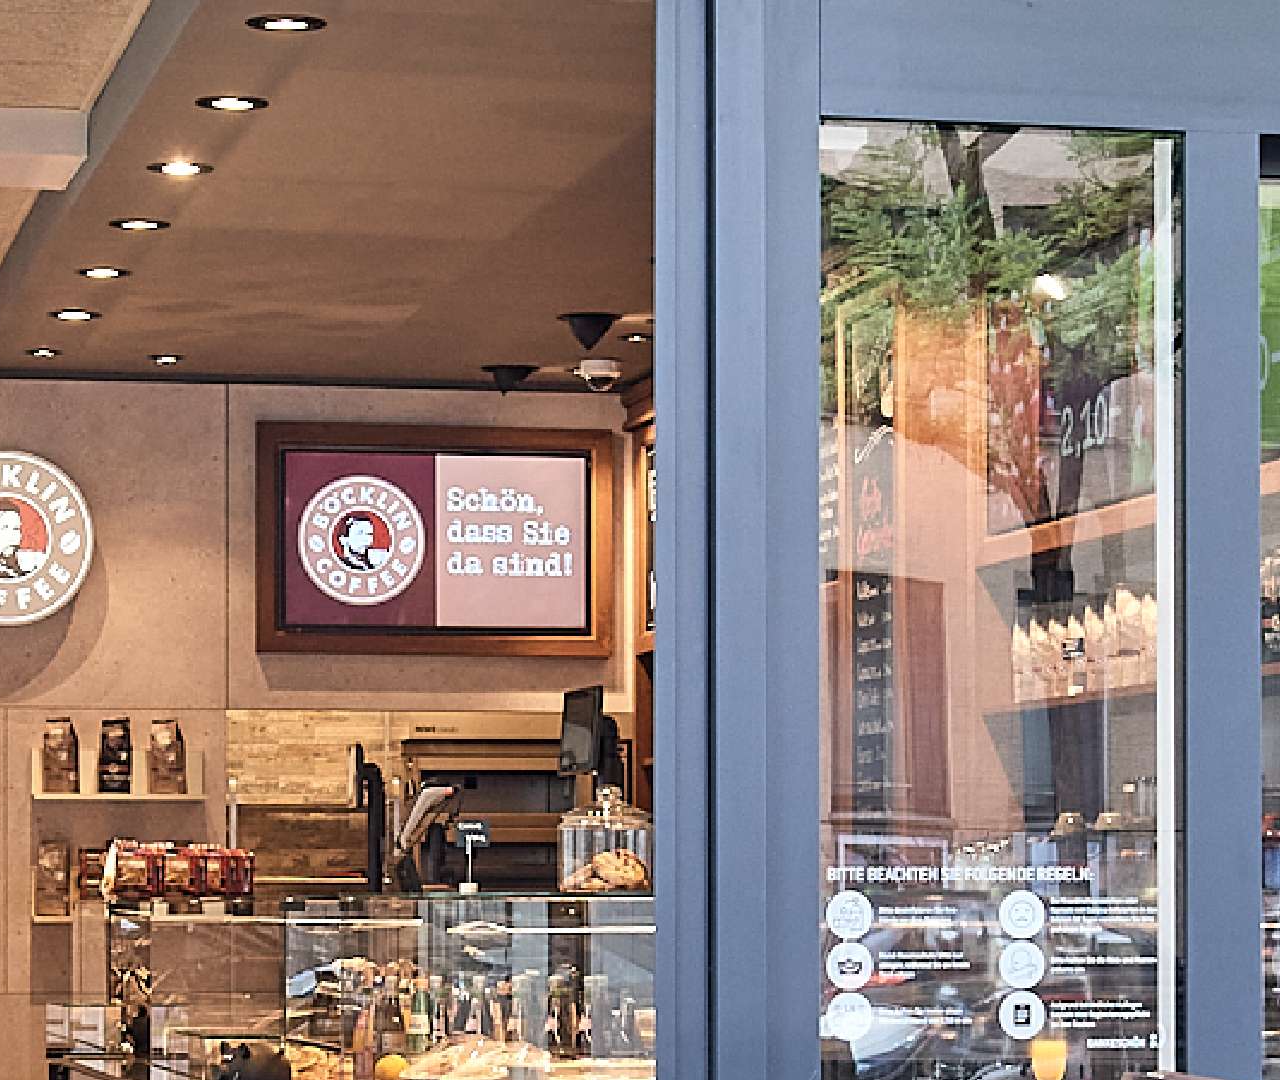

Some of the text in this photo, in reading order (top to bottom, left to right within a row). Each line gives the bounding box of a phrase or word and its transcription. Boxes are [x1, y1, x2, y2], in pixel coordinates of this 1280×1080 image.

[312, 485, 412, 530] BÖCKLIN
[446, 486, 544, 516] Schön,
[446, 519, 571, 546] dass Sie
[316, 559, 408, 594] COFFEE
[446, 551, 573, 577] da sind!
[827, 866, 865, 882] BITTE
[866, 866, 938, 882] BEACHTEN
[940, 866, 962, 882] SIE
[964, 866, 1035, 882] FOLGENDE
